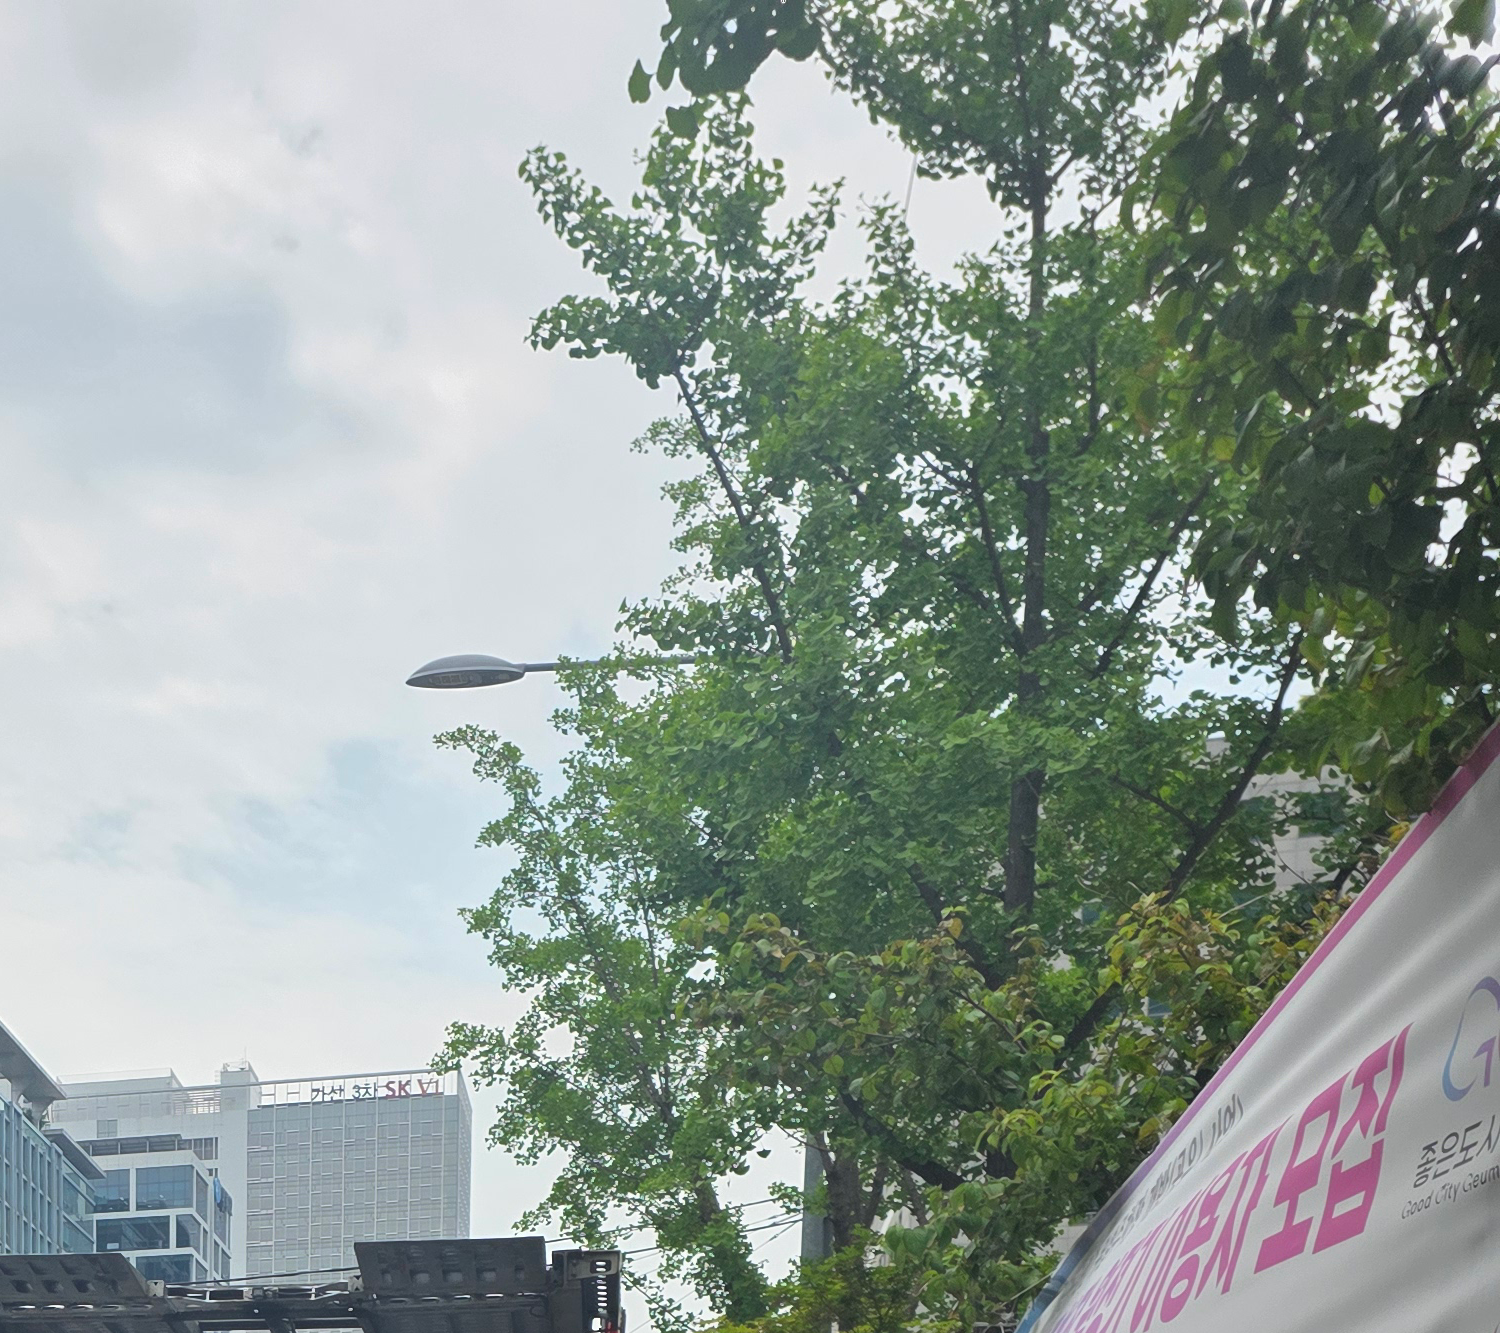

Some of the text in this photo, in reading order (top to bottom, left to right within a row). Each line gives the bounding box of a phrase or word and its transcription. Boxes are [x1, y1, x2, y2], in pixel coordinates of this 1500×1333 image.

[311, 1082, 344, 1101] 가산
[352, 1082, 378, 1100] 3차
[385, 1079, 411, 1099] SK
[1254, 1022, 1414, 1274] 모집
[1401, 1188, 1434, 1221] Good
